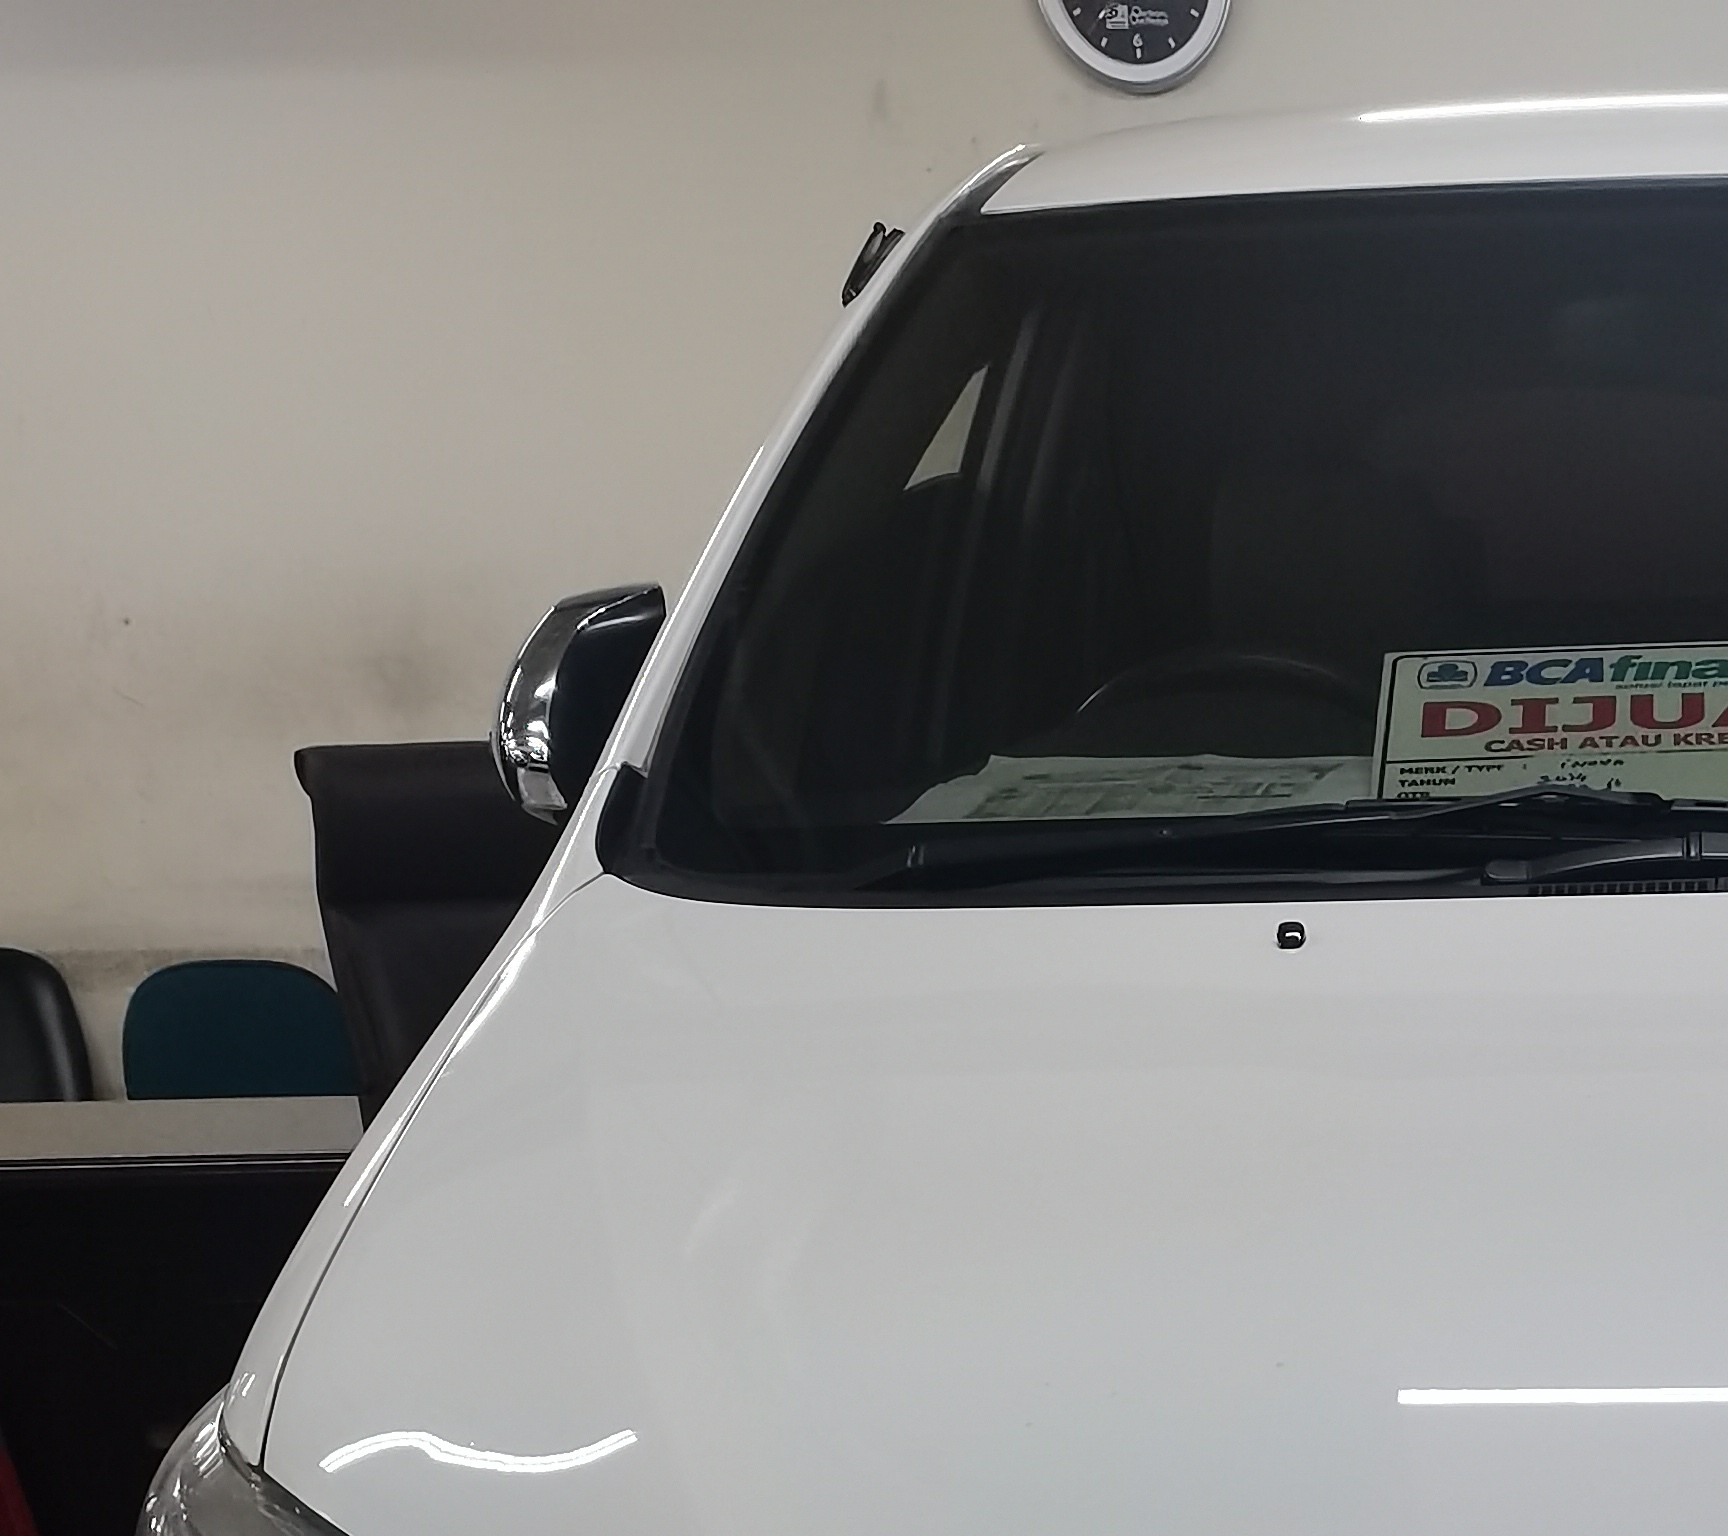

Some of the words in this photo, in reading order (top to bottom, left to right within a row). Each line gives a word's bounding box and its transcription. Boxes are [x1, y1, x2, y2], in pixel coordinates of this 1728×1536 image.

[1132, 33, 1144, 48] 6
[1484, 735, 1568, 753] CASH
[1579, 732, 1665, 751] ATAU
[1398, 777, 1456, 787] TAHUN
